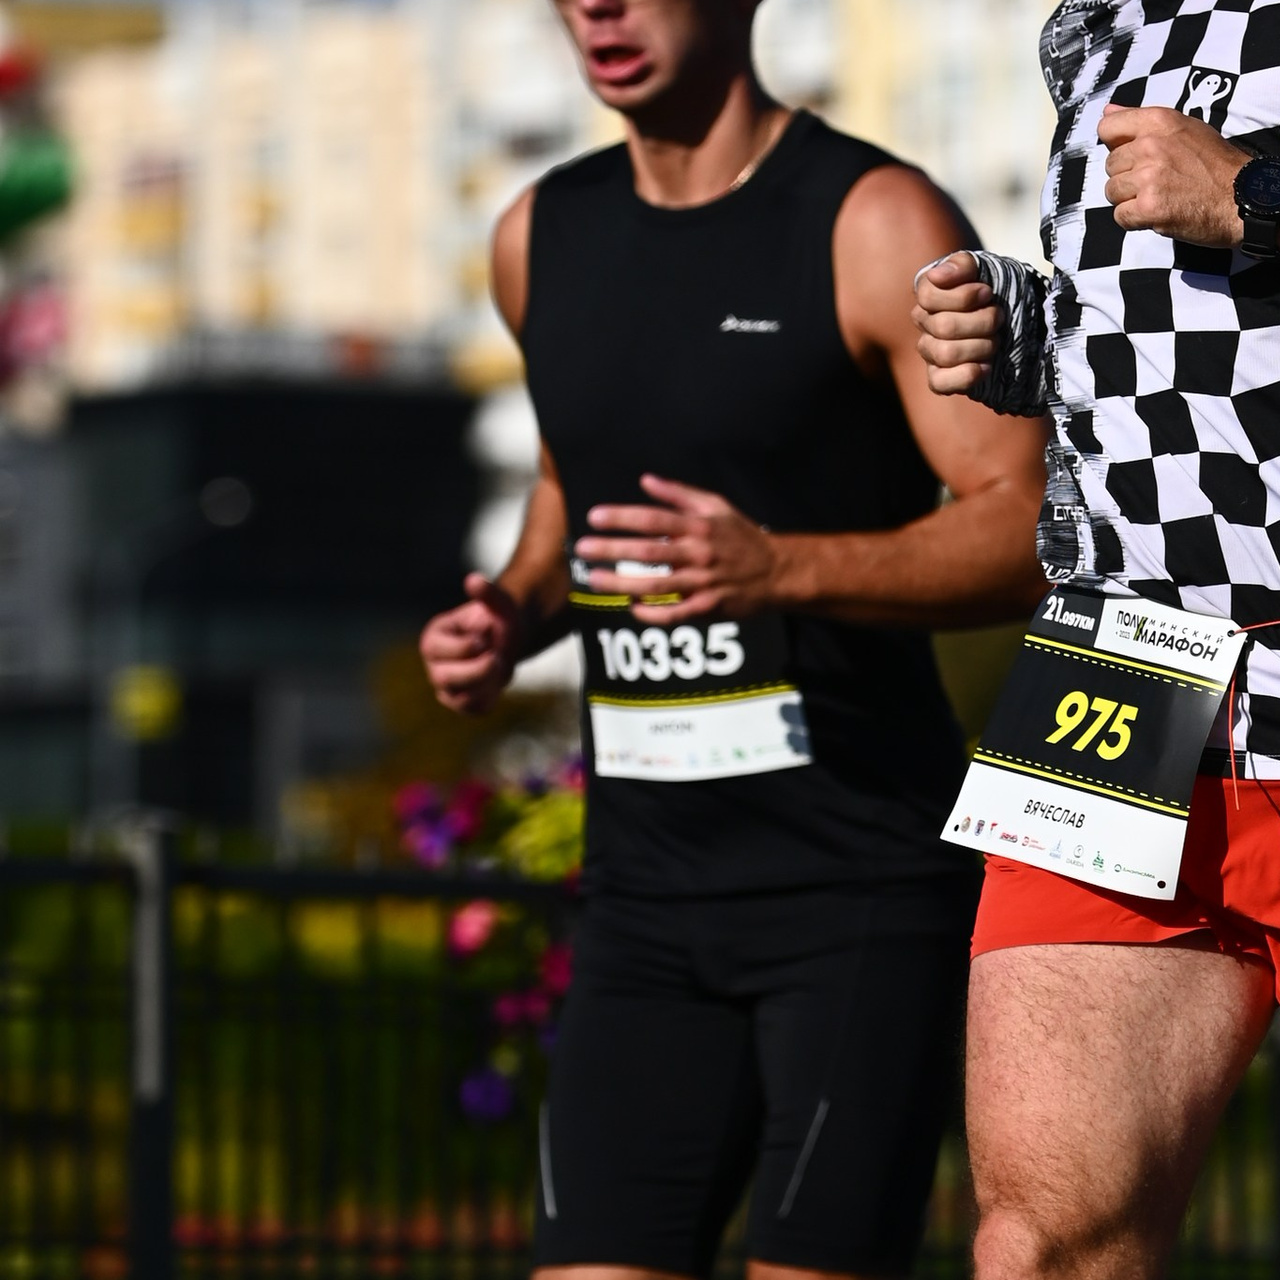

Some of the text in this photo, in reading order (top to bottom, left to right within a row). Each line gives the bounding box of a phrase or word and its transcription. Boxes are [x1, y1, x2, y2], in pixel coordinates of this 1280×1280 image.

[1138, 628, 1219, 661] МАРАФОН
[1149, 619, 1224, 644] МИНСКИЙ
[597, 621, 746, 682] 10335
[1045, 690, 1139, 761] 975
[1023, 799, 1086, 829] ВЯЧЕСЛАВ
